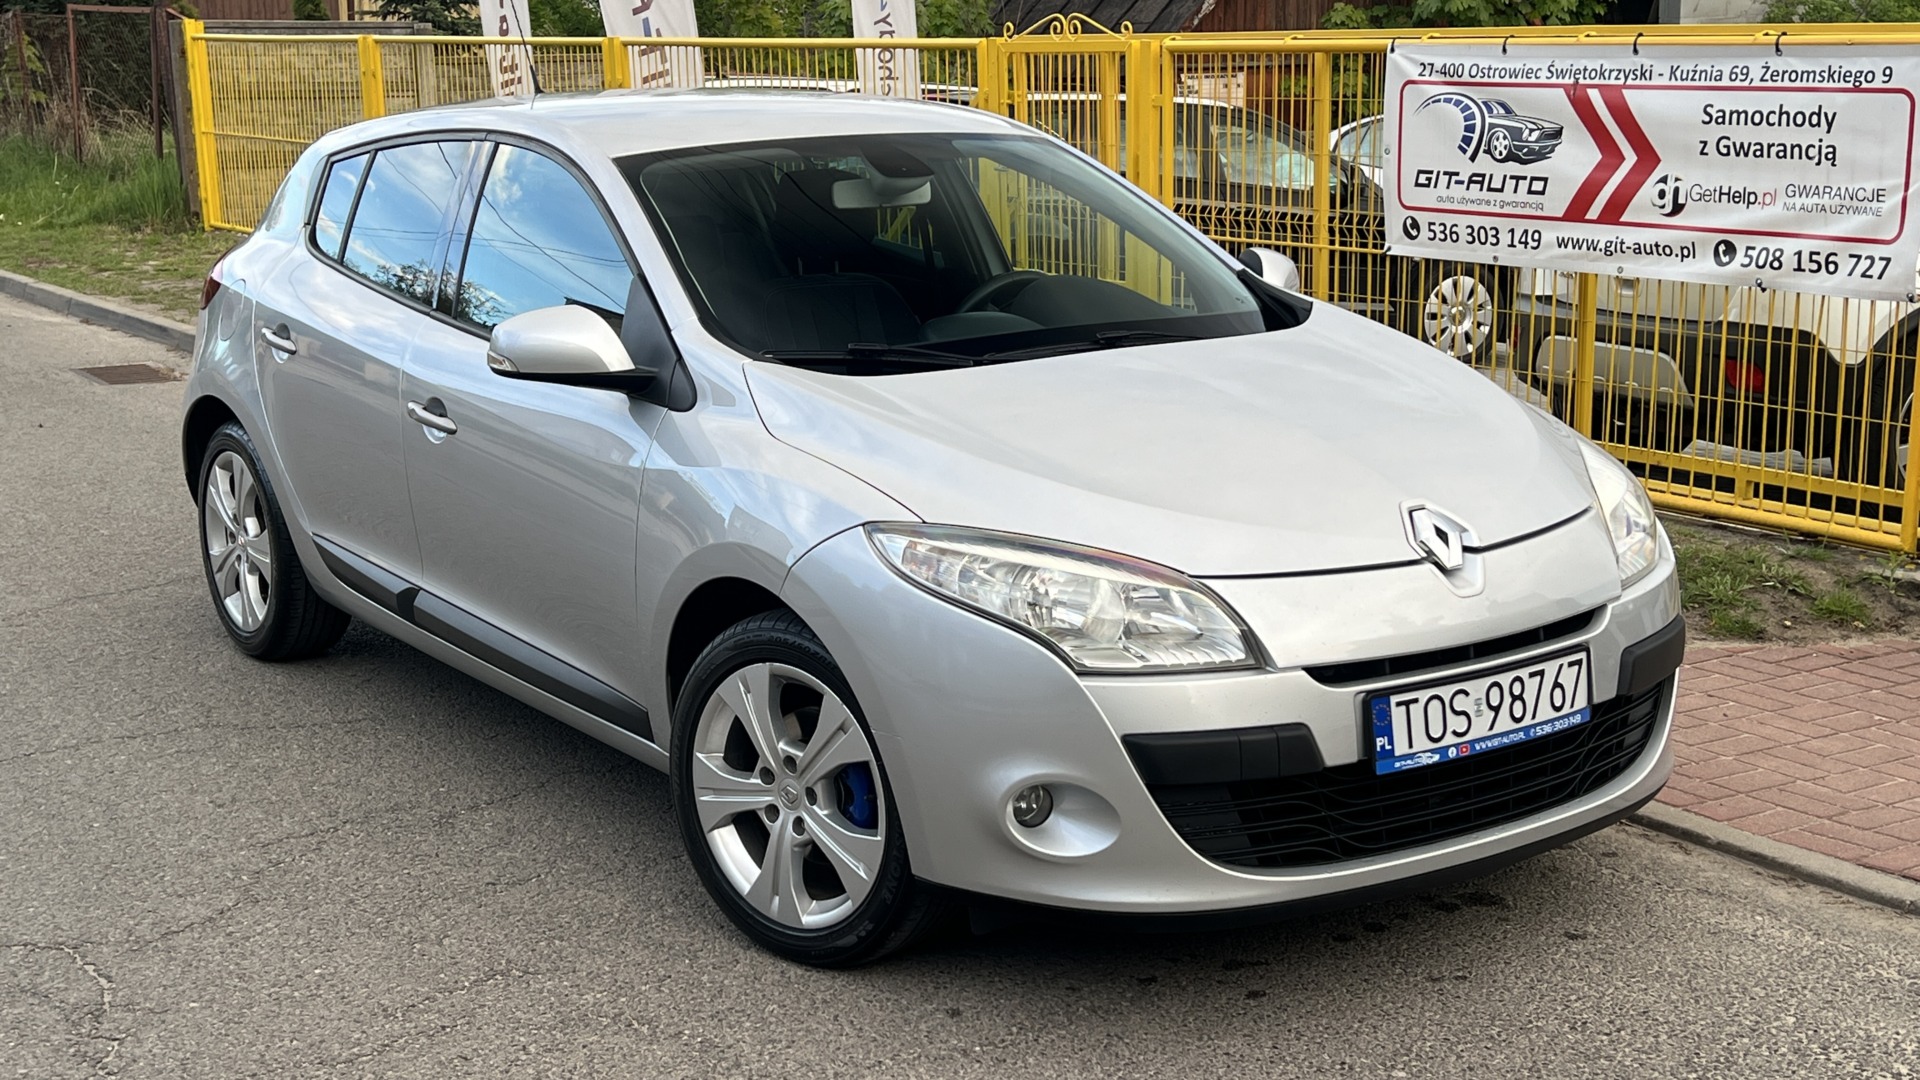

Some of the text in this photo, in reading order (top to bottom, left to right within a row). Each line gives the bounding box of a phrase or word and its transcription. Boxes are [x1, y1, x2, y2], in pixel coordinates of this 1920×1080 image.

[1417, 62, 1465, 79] 27-400
[1468, 63, 1543, 80] Ostrowiec
[1545, 60, 1654, 85] Świętokrzyski
[1668, 64, 1724, 82] Kuźnia
[1728, 65, 1754, 85] 69,
[1759, 61, 1876, 88] Żeromskiego
[1881, 66, 1893, 84] 9
[1701, 103, 1838, 134] Samochody
[1698, 135, 1838, 167] z Gwarancją
[1413, 169, 1550, 196] GIT-AUTO
[1689, 183, 1778, 210] GetHelp.pl
[1785, 183, 1888, 204] GWARANCJE
[1436, 194, 1545, 212] auta używane z gwarancją
[1781, 202, 1797, 214] NA
[1798, 203, 1828, 215] AUTA
[1427, 221, 1542, 251] 536 303 149
[1555, 235, 1697, 263] www.git-auto.pl
[1740, 245, 1893, 281] 508 156 727
[1395, 657, 1584, 750] TOS 98767
[1375, 736, 1392, 752] PL
